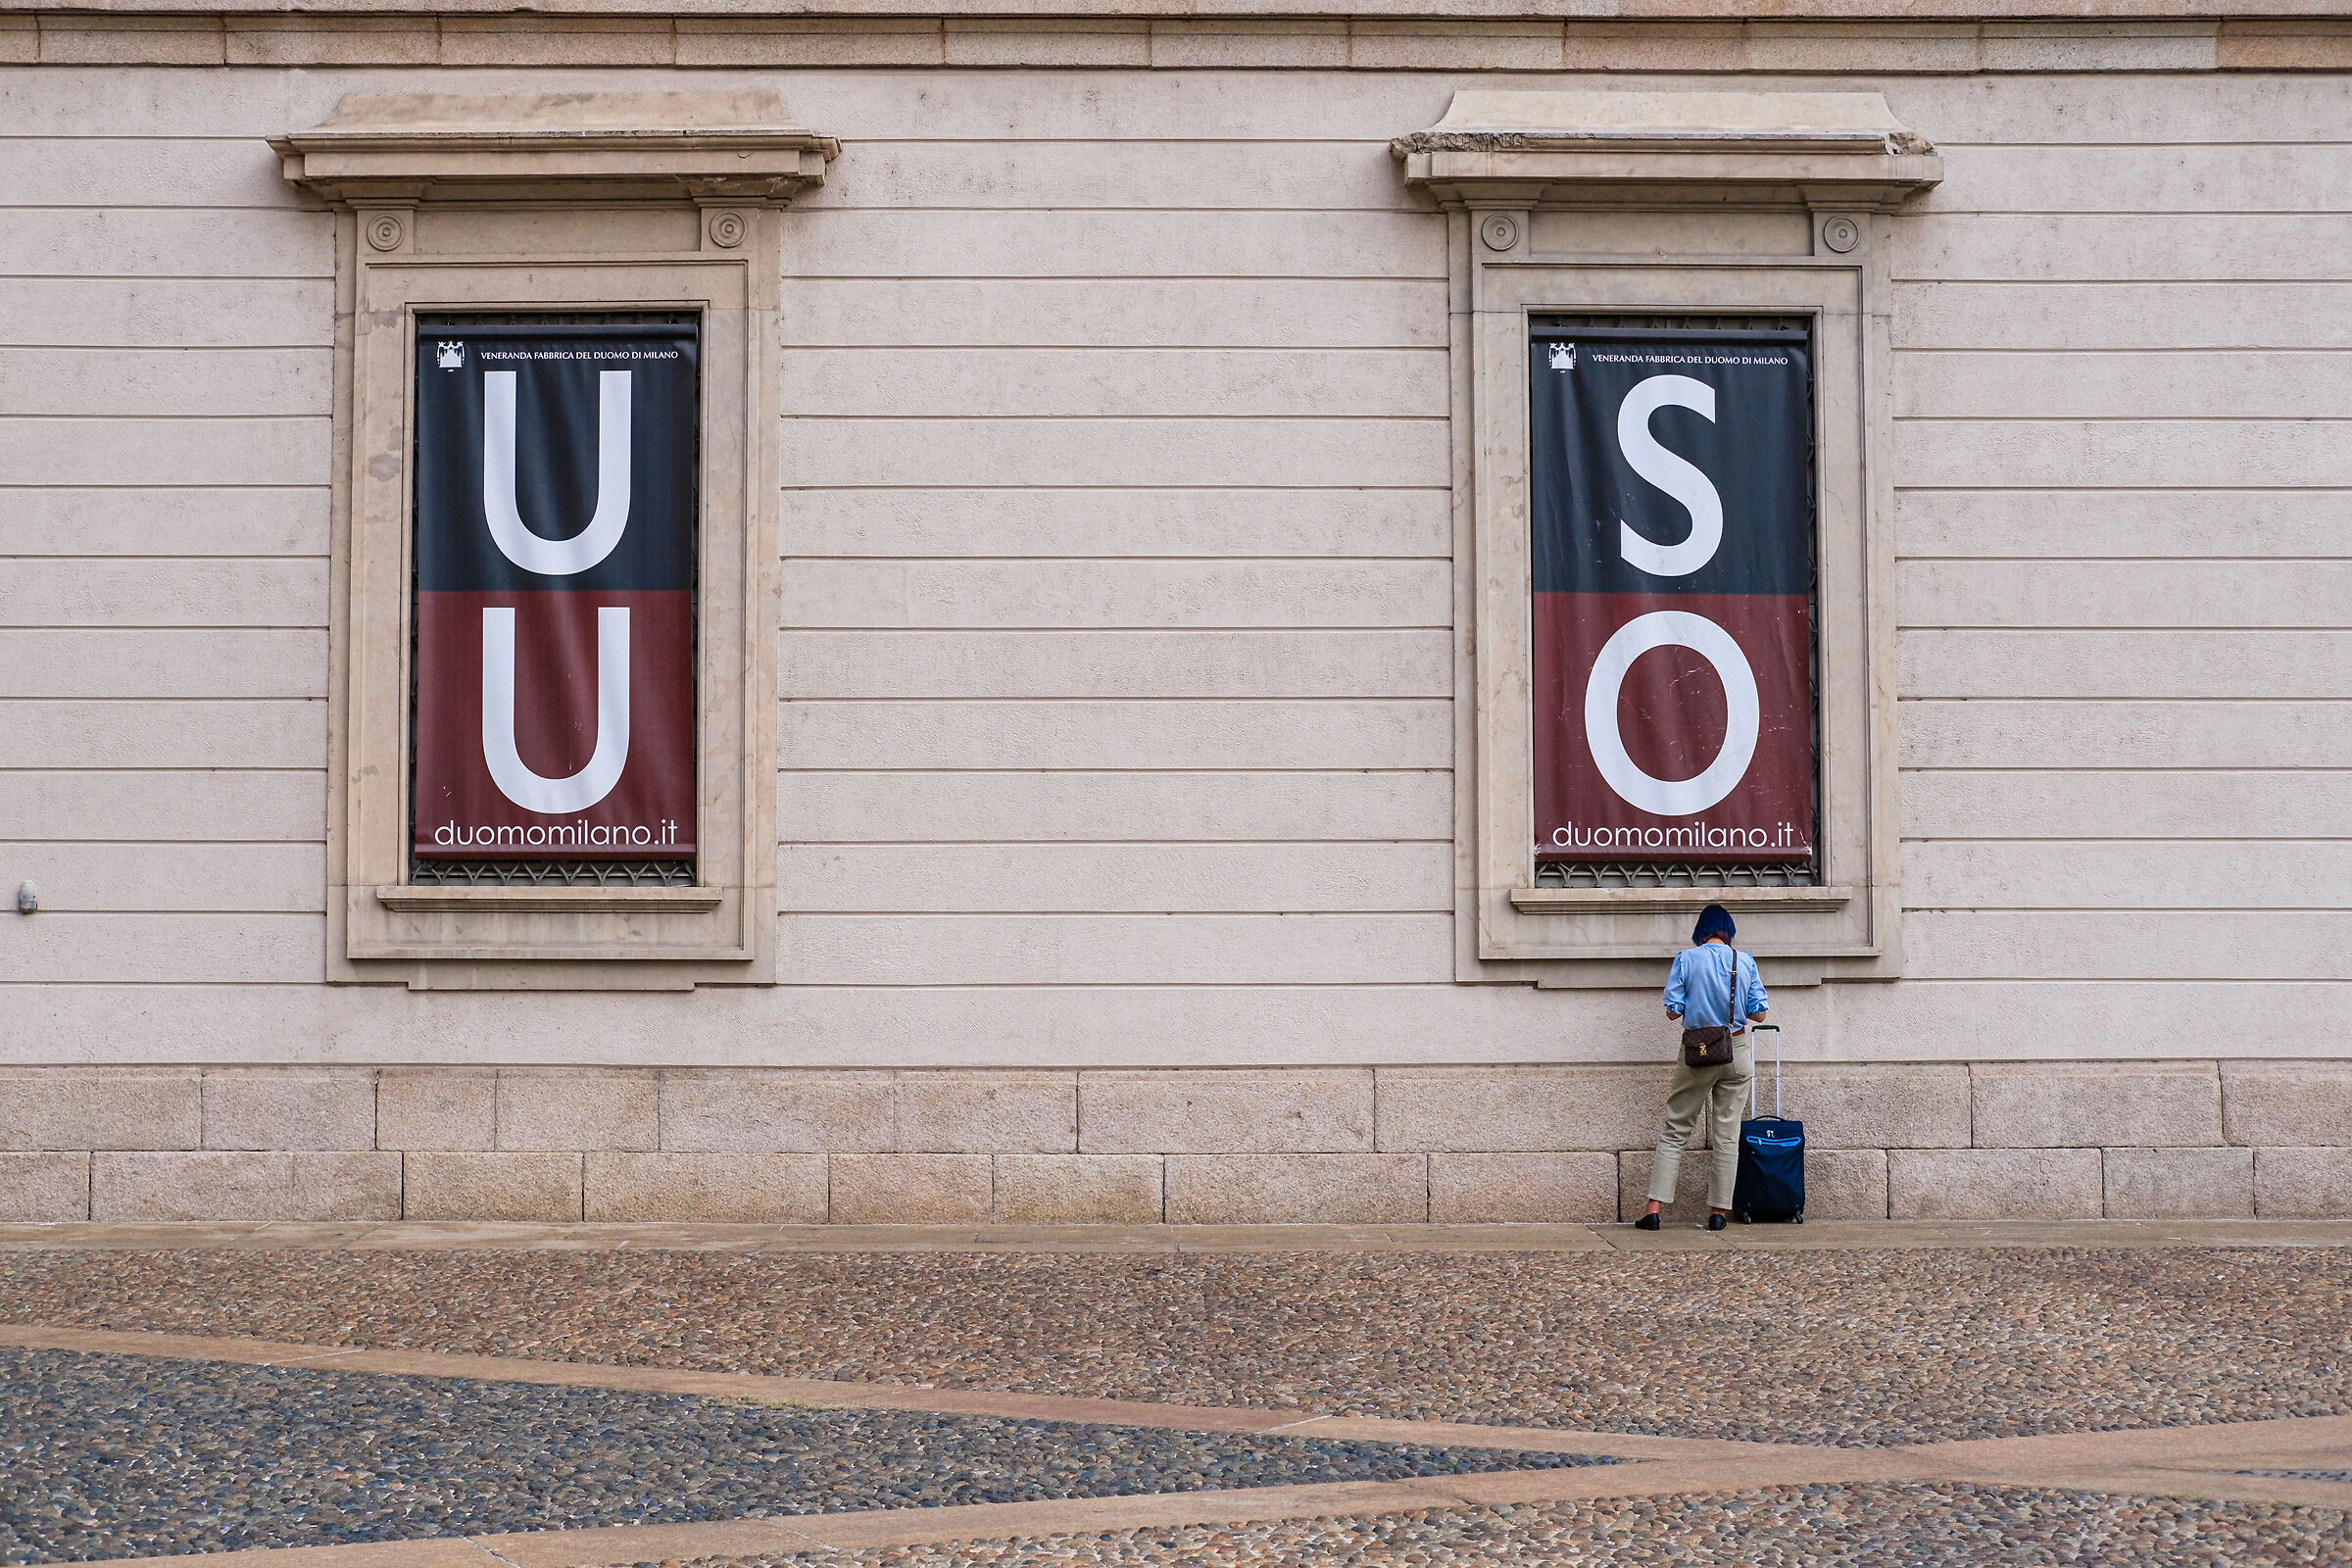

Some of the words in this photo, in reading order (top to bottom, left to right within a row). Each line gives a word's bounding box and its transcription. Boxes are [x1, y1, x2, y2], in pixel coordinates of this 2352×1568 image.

[480, 351, 532, 360] VENERANDA
[534, 351, 575, 360] FABBRICA
[576, 351, 593, 360] DEL
[594, 351, 630, 360] DUOMO
[632, 351, 642, 360] DI
[643, 351, 679, 360] MILANO
[1592, 354, 1644, 364] VENERANDA
[1645, 355, 1686, 365] FABBRICA
[1688, 355, 1703, 365] DEL
[1704, 356, 1740, 366] DUOMO
[1742, 356, 1752, 366] DI
[1753, 357, 1788, 366] MILANO
[484, 370, 631, 575] U
[1617, 374, 1724, 576] S
[482, 607, 630, 814] U
[1585, 611, 1760, 816] O
[434, 819, 678, 847] duomomilano.it
[1552, 821, 1793, 848] duomomilano.it
